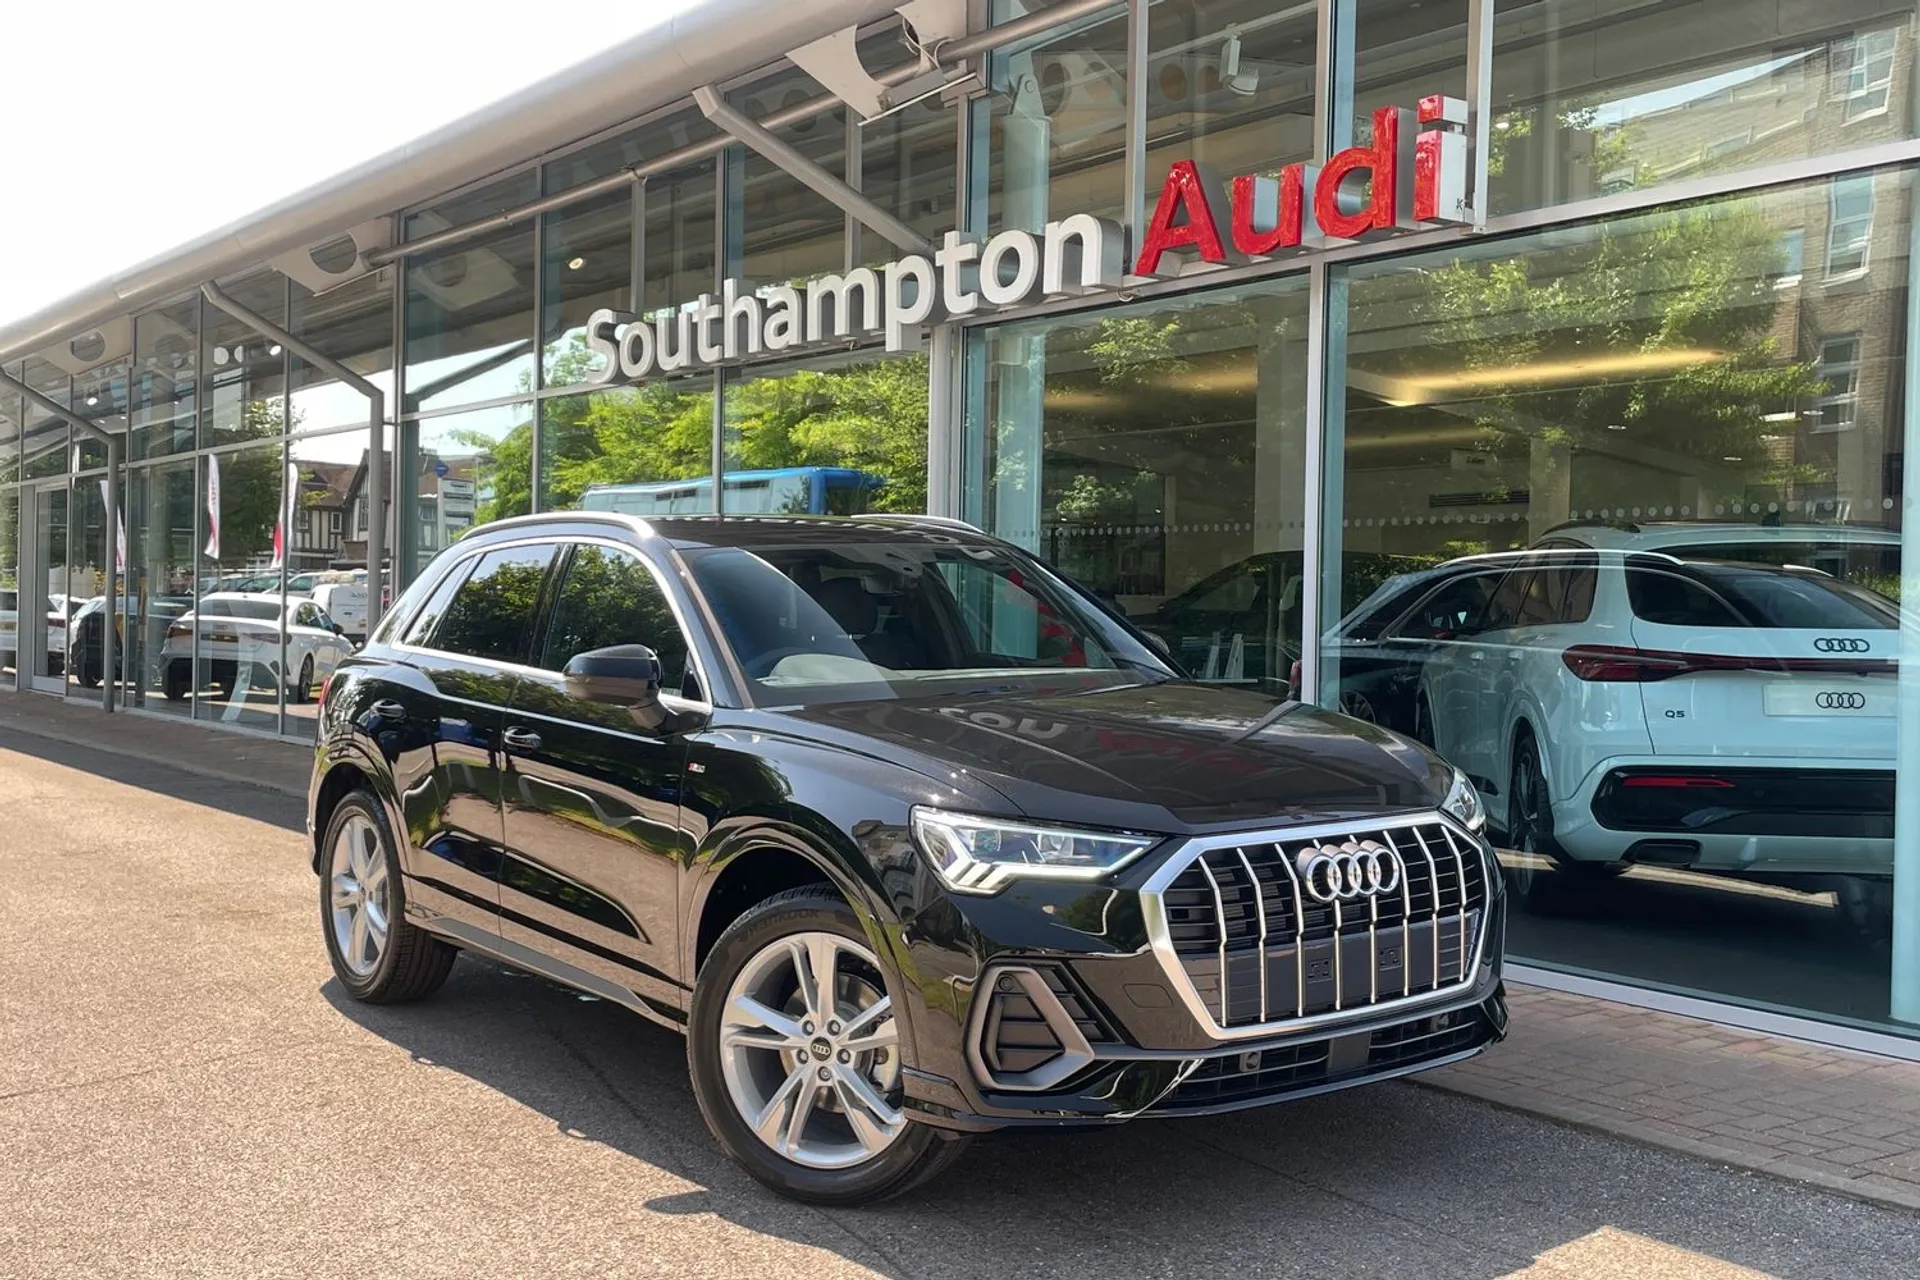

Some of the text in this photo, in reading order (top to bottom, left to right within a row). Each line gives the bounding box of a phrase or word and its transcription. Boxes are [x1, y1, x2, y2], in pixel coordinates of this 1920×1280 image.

[586, 94, 1450, 384] Southampton Audi
[1665, 710, 1685, 719] Q5
